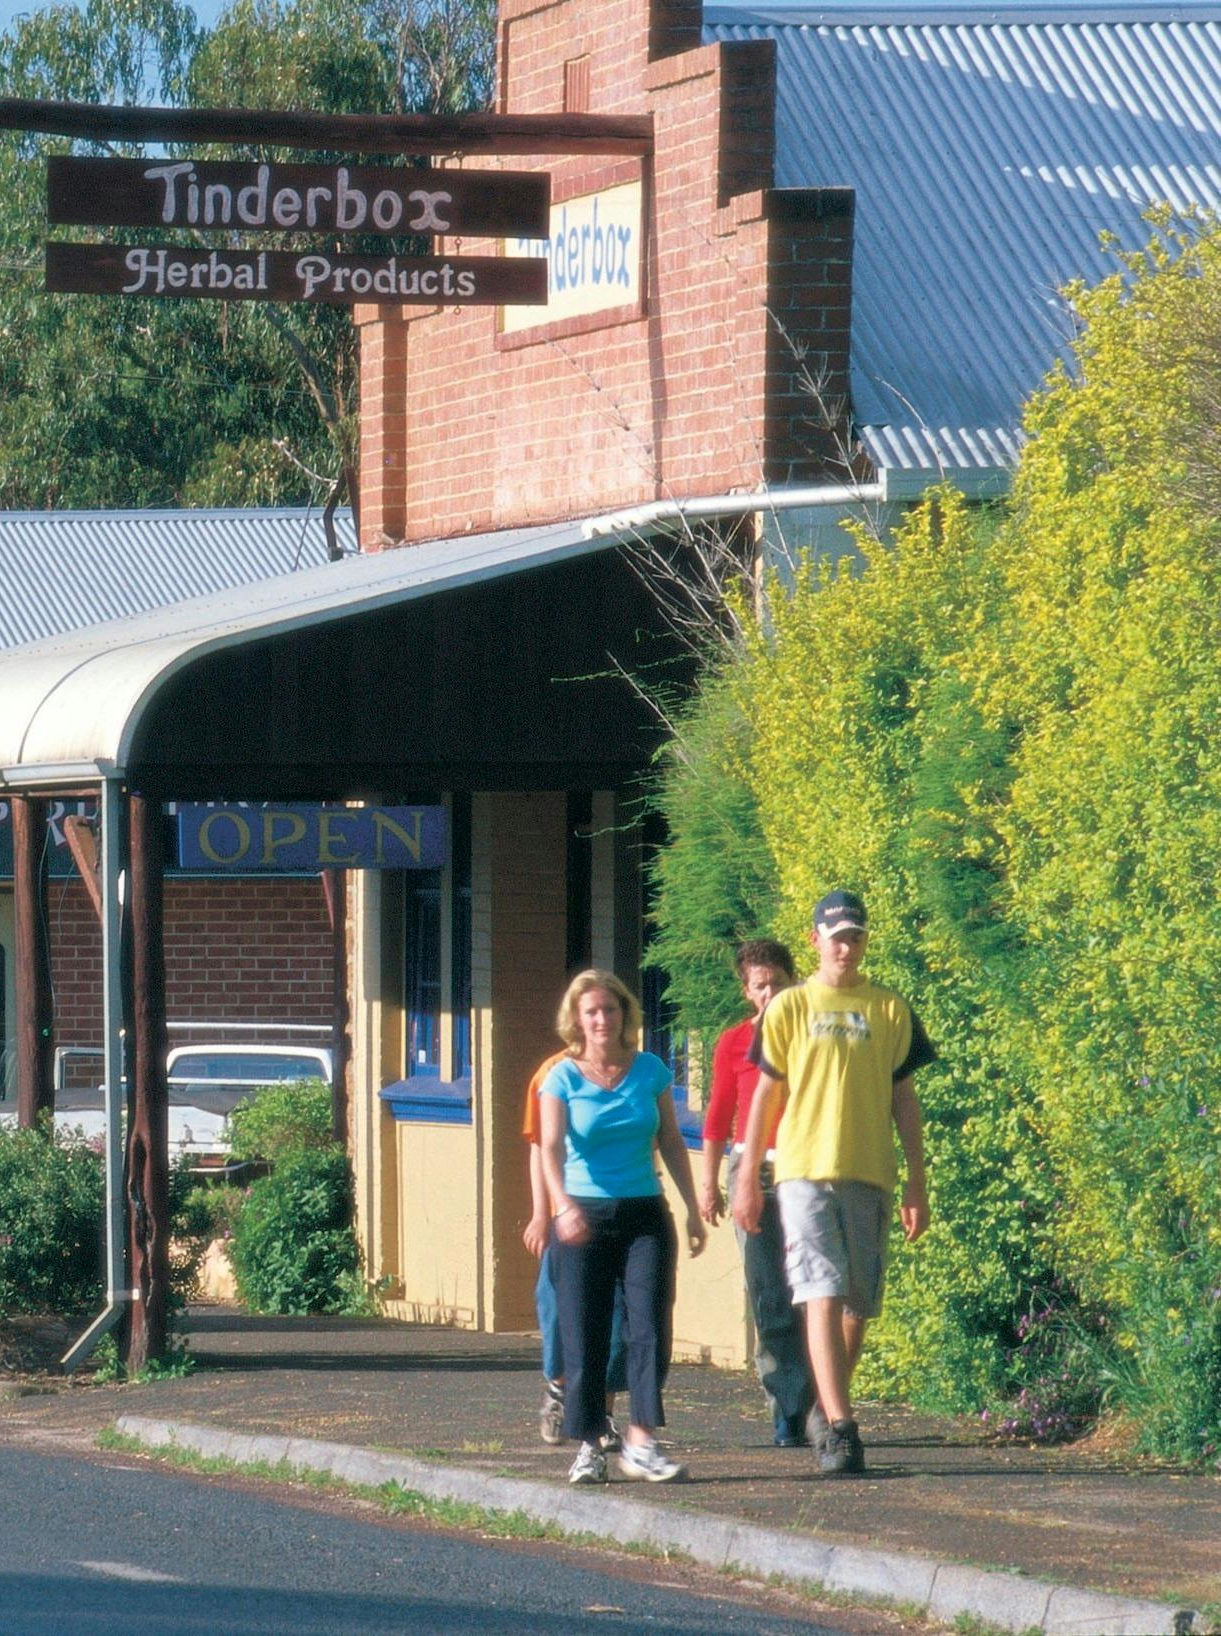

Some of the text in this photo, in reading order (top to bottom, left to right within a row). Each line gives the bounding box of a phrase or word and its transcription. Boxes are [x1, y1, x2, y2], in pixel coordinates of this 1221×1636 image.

[144, 162, 452, 231] Tinderbox
[123, 249, 476, 298] Herbal Products
[518, 197, 631, 294] nderbox
[198, 811, 424, 864] OPEN
